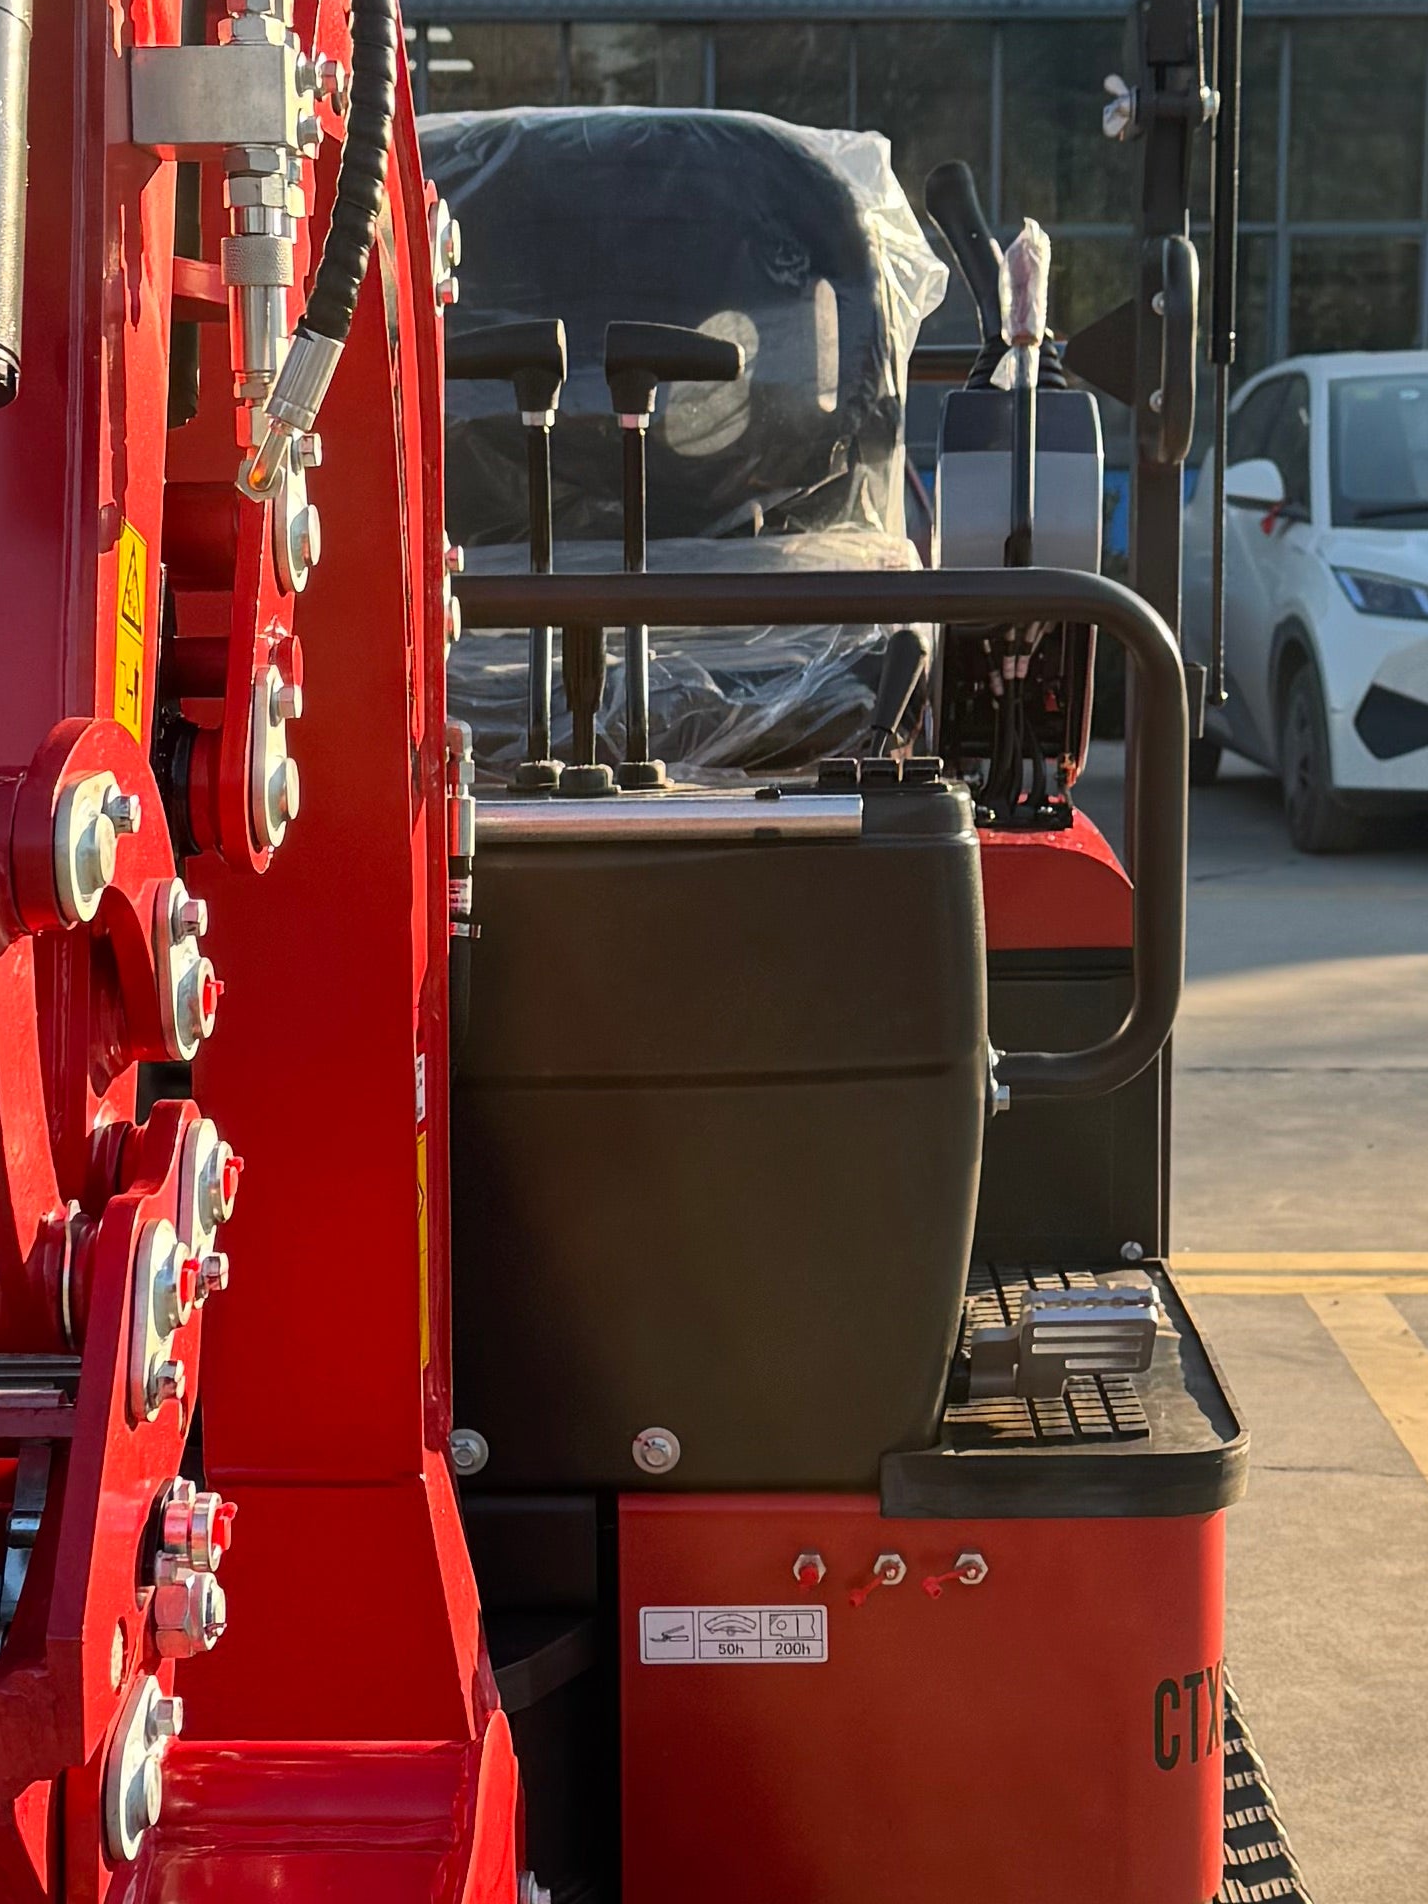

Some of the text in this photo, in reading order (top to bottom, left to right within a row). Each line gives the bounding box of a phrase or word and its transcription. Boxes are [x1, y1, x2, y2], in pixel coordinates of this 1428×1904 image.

[718, 1642, 744, 1656] 50h
[775, 1642, 811, 1656] 200h
[1154, 1659, 1222, 1771] CTX
